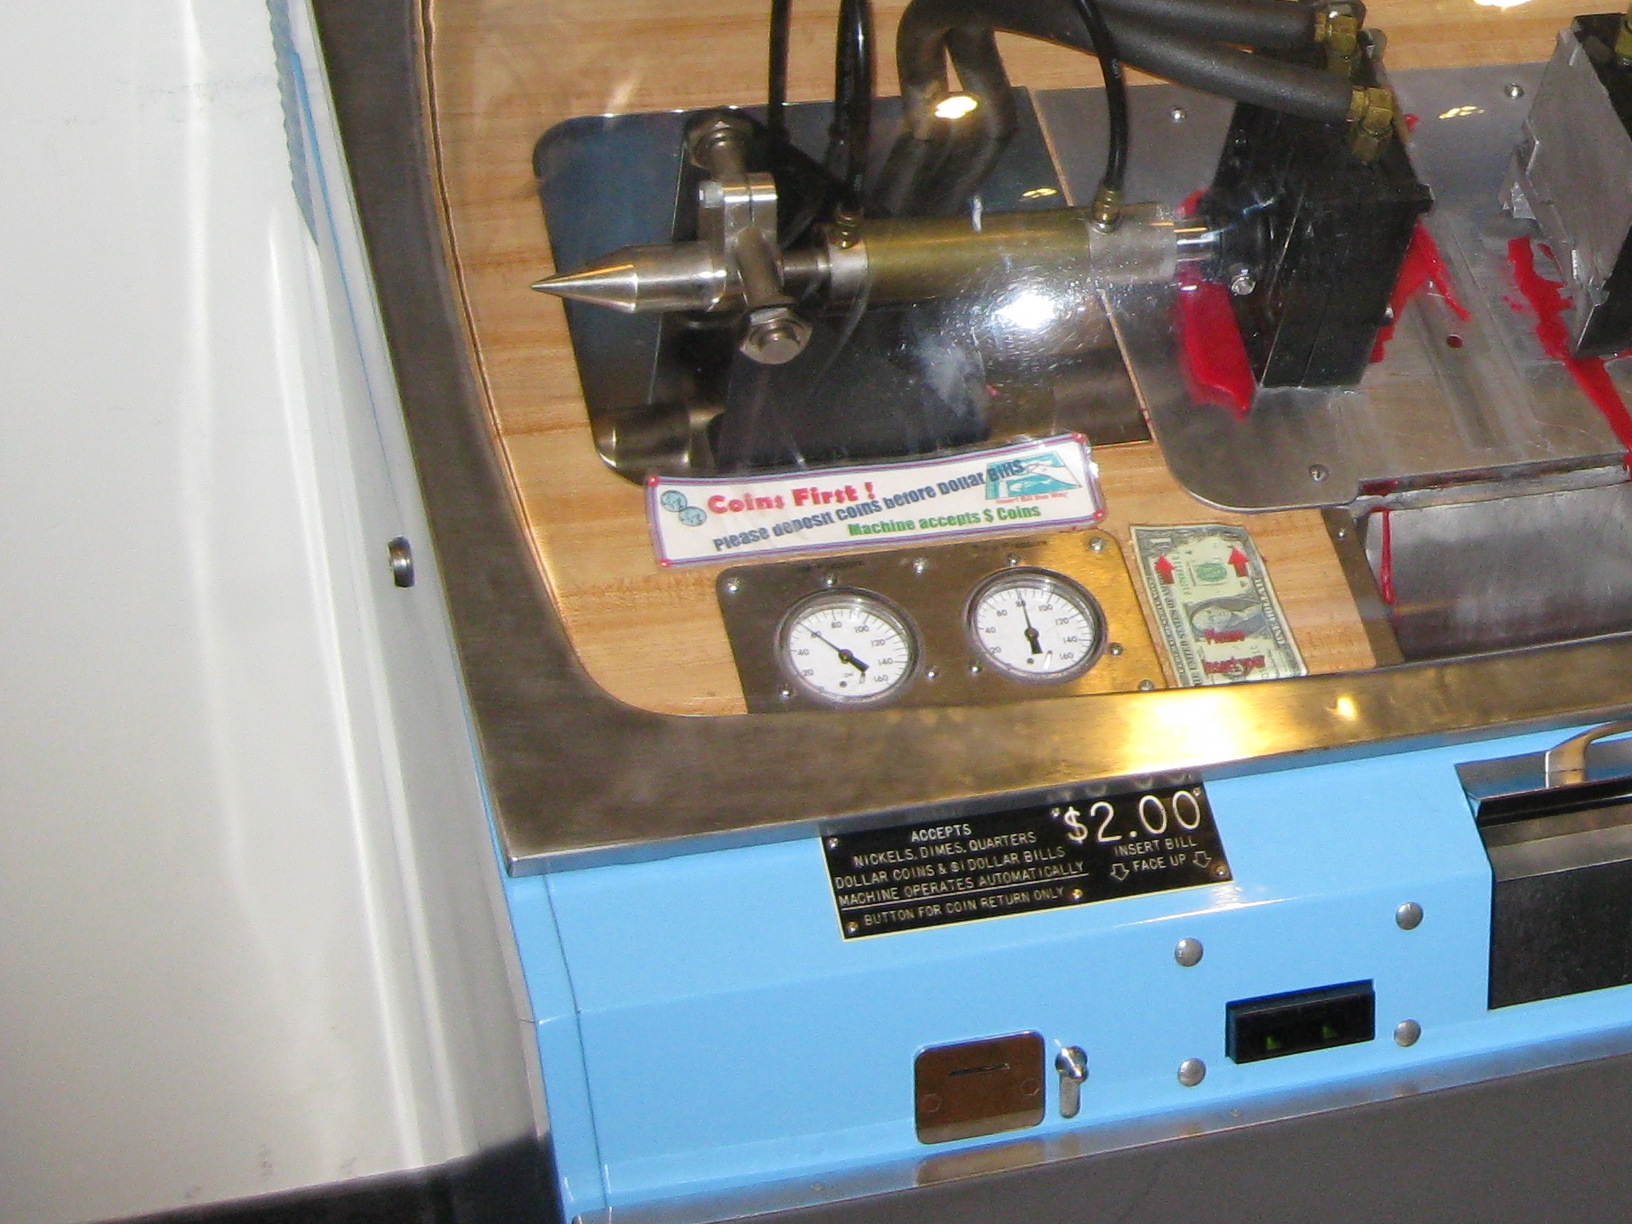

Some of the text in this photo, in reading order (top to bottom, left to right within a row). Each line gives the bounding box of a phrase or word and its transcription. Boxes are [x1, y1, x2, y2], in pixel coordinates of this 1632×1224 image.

[707, 492, 786, 515] Coins
[791, 485, 859, 508] First
[713, 526, 770, 551] Please
[773, 512, 834, 537] deposit
[835, 497, 882, 522] coins
[885, 485, 937, 510] before
[938, 472, 985, 496] Dollar
[848, 505, 1042, 536] Machine accepts $ Coins
[1038, 604, 1054, 612] 100
[1253, 577, 1286, 645] ONE DOLLAR
[996, 609, 1008, 617] 60
[831, 621, 843, 629] 80
[1055, 617, 1070, 626] 120
[855, 624, 870, 633] 100
[985, 626, 997, 634] 40
[871, 638, 886, 647] 120
[1063, 635, 1078, 644] 140
[797, 648, 810, 656] 40
[990, 646, 1002, 654] 20
[1059, 652, 1074, 660] 160
[802, 668, 815, 676] 20
[874, 674, 888, 683] 160
[1064, 789, 1201, 844] $2.00
[911, 823, 972, 843] ACCEPTS
[968, 831, 1037, 851] QUARTERS
[1113, 835, 1197, 857] INSERT BILL
[1132, 853, 1188, 872] FACE UP
[834, 869, 889, 890] DOLLAR
[892, 861, 935, 882] COINS
[938, 862, 947, 875] &
[968, 852, 1021, 871] DOLLAR
[1024, 845, 1066, 863] BILLS
[838, 860, 1085, 907] MACHINE OPERATES AUTOMATICALLY
[863, 885, 1065, 926] BUTTON FOR COIN RETURN ONLY
